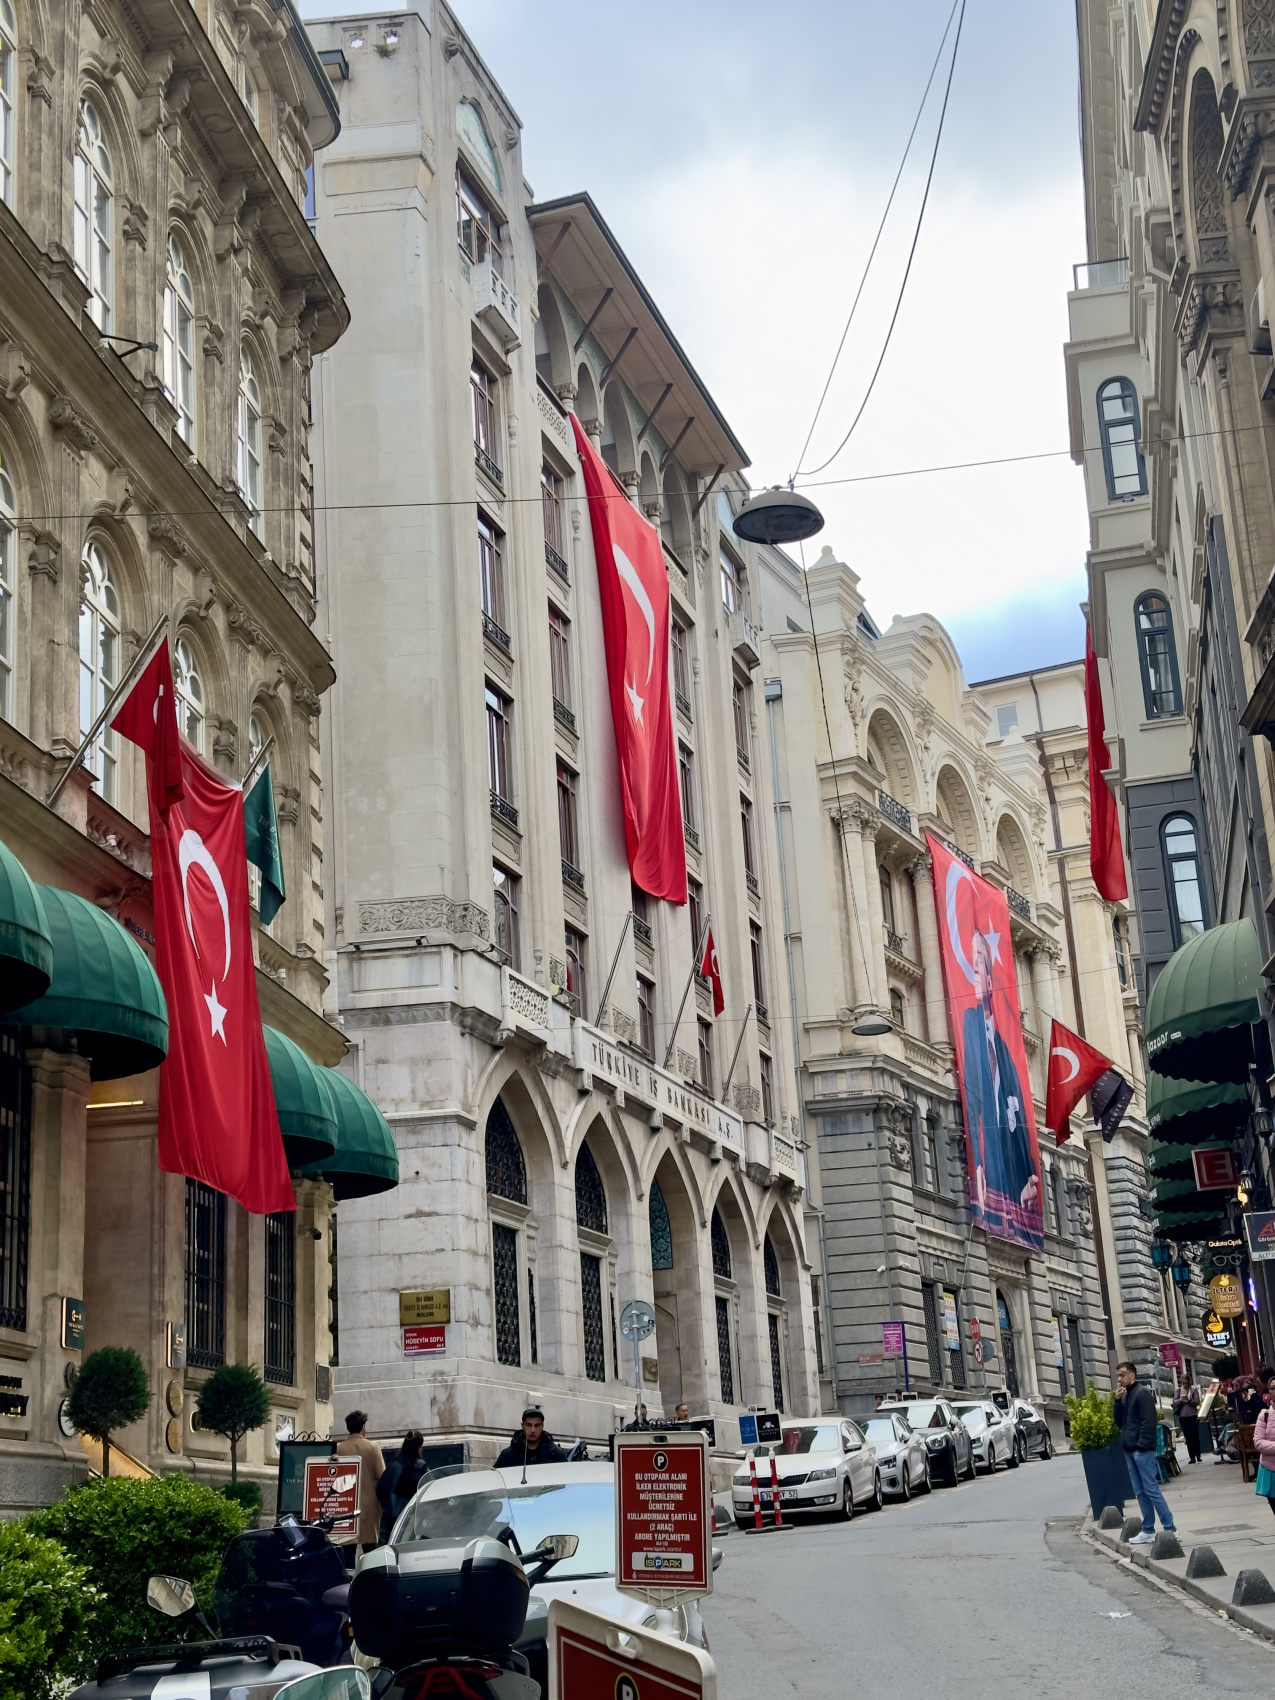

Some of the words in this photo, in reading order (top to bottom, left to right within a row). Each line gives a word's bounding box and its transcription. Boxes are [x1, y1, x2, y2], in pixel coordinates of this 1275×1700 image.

[592, 1042, 640, 1086] TÜRKİYE
[649, 1071, 658, 1098] İŞ
[667, 1086, 710, 1125] BANKASI
[718, 1116, 734, 1139] A.Ş.
[635, 1482, 652, 1491] İLKER
[652, 1482, 687, 1491] ELEKTRONİK
[639, 1491, 684, 1502] MÜŞTERİLERİNE
[788, 1490, 796, 1498] 52
[648, 1501, 676, 1511] ÜCRETSİZ
[626, 1512, 669, 1520] KULLANDIRMAK
[670, 1513, 688, 1522] ŞARTI
[688, 1511, 698, 1521] İLE
[649, 1522, 656, 1531] (2
[656, 1523, 675, 1533] ARAÇ)
[634, 1532, 653, 1541] ABONE
[654, 1533, 691, 1542] YAPILMIŞTIR
